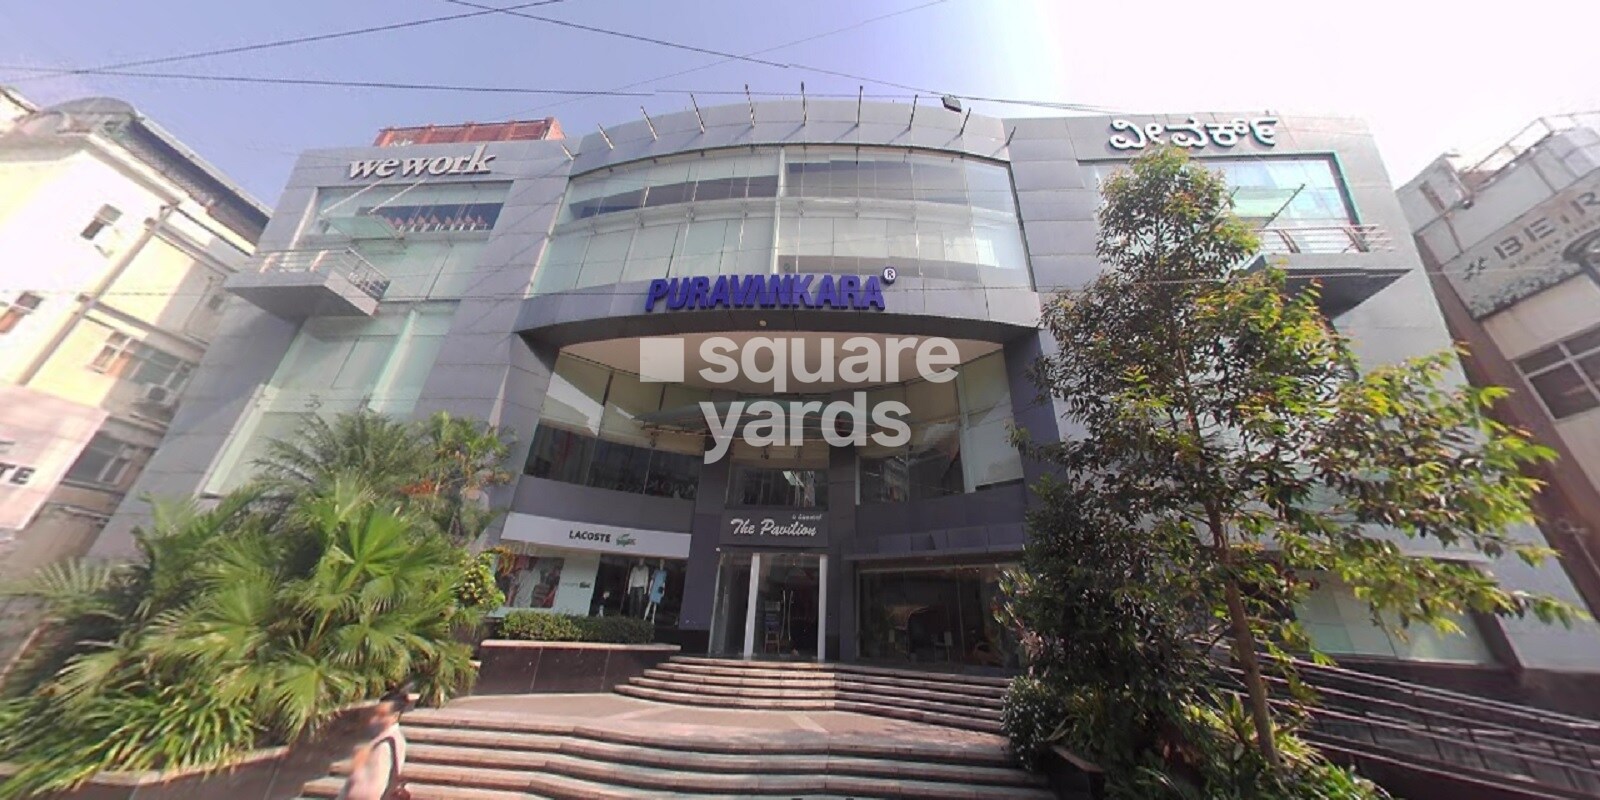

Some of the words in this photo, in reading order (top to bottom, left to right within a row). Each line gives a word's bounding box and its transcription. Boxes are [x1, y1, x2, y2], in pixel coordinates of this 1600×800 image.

[644, 274, 886, 312] PURAVANKARA
[569, 529, 612, 543] LACOSTE
[730, 518, 755, 535] The
[760, 517, 816, 536] Pavilion
